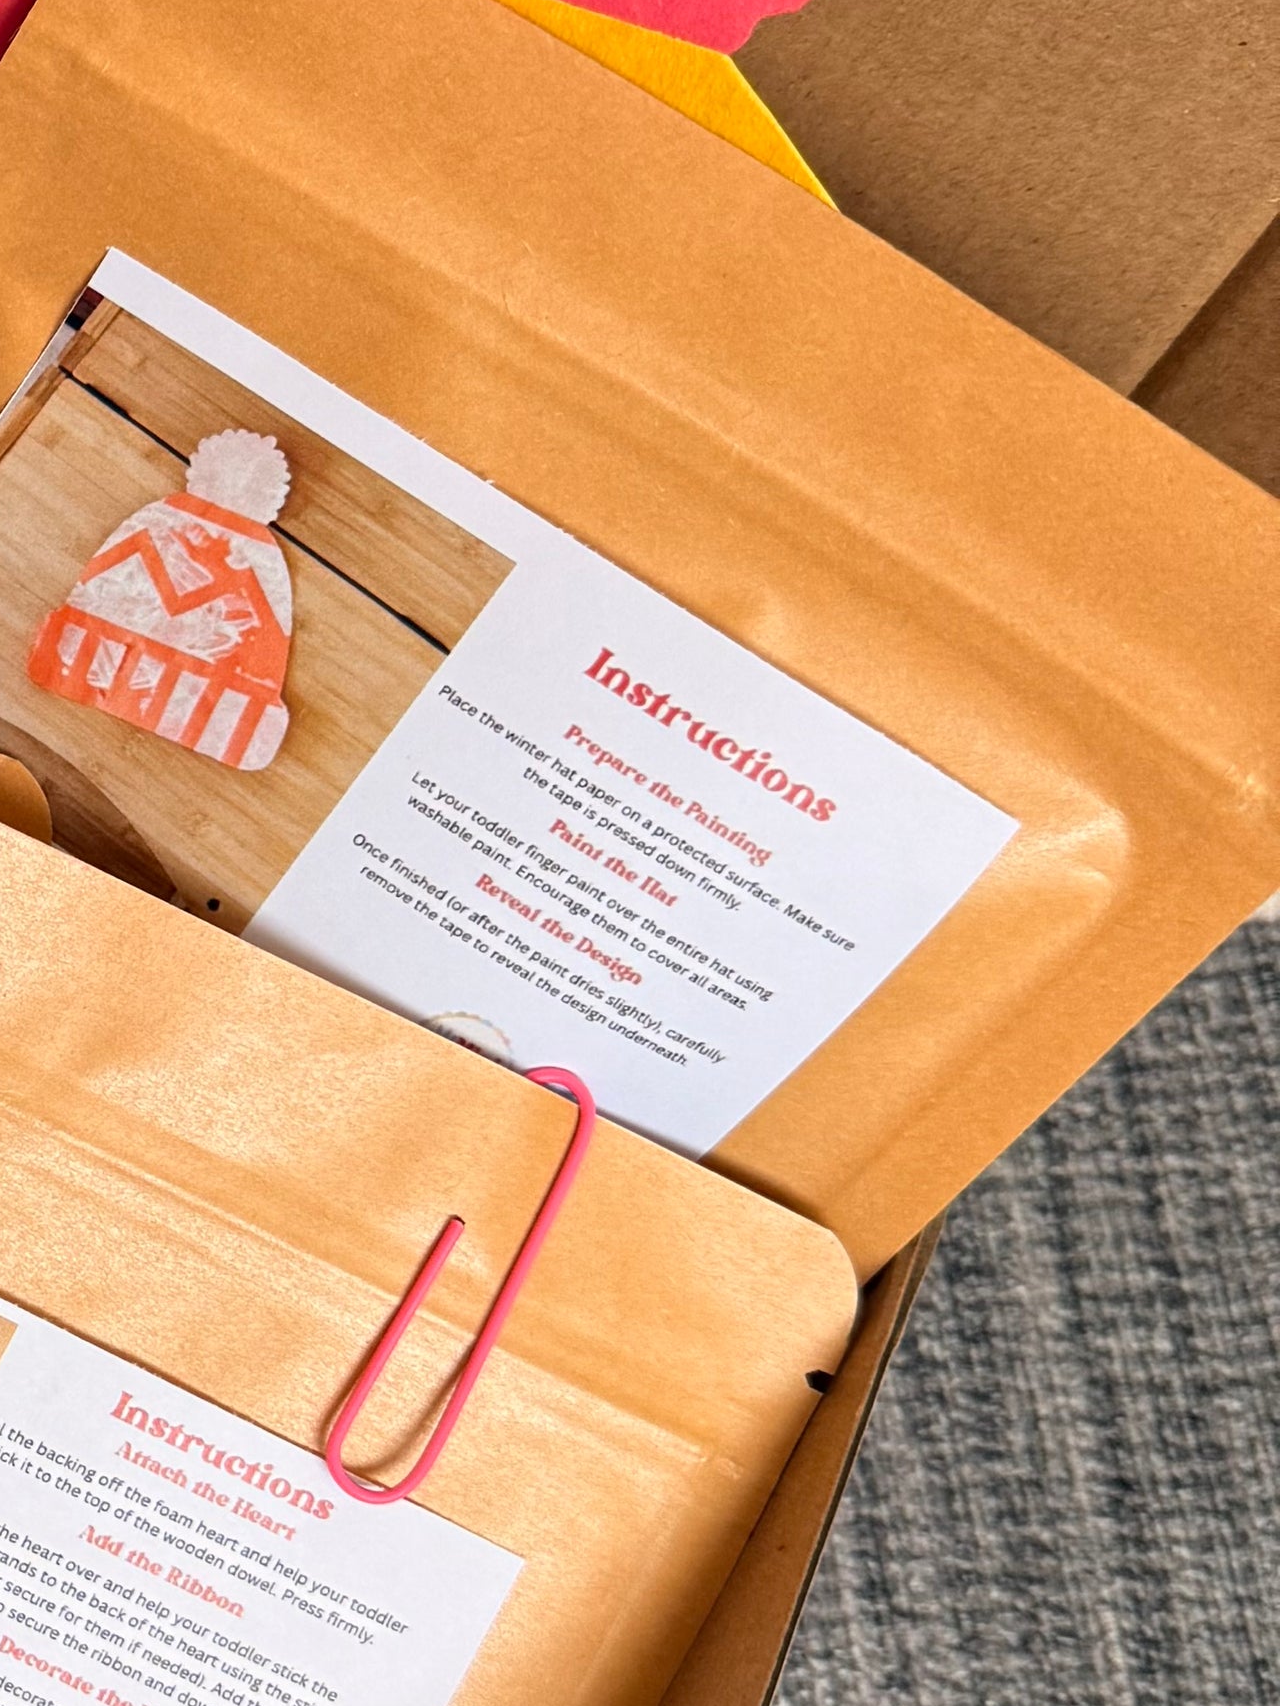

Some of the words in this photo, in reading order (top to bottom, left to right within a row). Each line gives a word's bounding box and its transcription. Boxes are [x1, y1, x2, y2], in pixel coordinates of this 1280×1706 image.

[562, 724, 648, 785] Prepare
[647, 781, 685, 808] the
[683, 800, 773, 867] Painting
[583, 647, 836, 821] Instructions
[411, 771, 437, 794] Let
[433, 788, 472, 814] your
[470, 810, 525, 849] toddler
[524, 844, 569, 877] finger
[564, 873, 607, 903] paint
[606, 898, 641, 922] over
[639, 918, 667, 939] the
[665, 935, 710, 965] entire
[708, 957, 736, 980] hat
[733, 974, 774, 1003] using
[437, 684, 479, 717] Place
[478, 711, 505, 734] the
[504, 729, 552, 763] winter
[550, 757, 578, 782] hat
[574, 777, 622, 808] paper
[620, 805, 642, 823] on
[641, 818, 653, 831] a
[650, 825, 728, 875] protected
[724, 870, 781, 910] surface.
[783, 903, 824, 933] Make
[821, 929, 856, 952] sure
[522, 766, 550, 789] the
[548, 783, 583, 811] tape
[582, 804, 598, 821] is
[594, 816, 658, 857] pressed
[655, 853, 697, 883] down
[696, 876, 742, 911] firmly.
[548, 818, 605, 861] Paint
[602, 857, 639, 882] the
[638, 875, 678, 907] Hat
[474, 873, 543, 923] Reveal
[539, 918, 575, 944] the
[574, 936, 642, 986] Design
[109, 1390, 335, 1520] Instructions
[114, 1441, 188, 1489] Attach
[190, 1481, 231, 1507] the
[230, 1496, 297, 1542] Heart
[6, 1428, 35, 1450] the
[35, 1440, 97, 1484] backing
[97, 1475, 125, 1493] off
[123, 1486, 152, 1508] the
[153, 1499, 194, 1529] foam
[195, 1520, 240, 1553] heart
[239, 1545, 273, 1568] and
[272, 1558, 309, 1587] help
[307, 1580, 349, 1605] your
[349, 1598, 409, 1634] toddler
[19, 1457, 34, 1475] it
[34, 1466, 52, 1484] to
[54, 1476, 82, 1498] the
[83, 1490, 112, 1514] top
[113, 1507, 135, 1523] of
[133, 1515, 161, 1538] the
[162, 1531, 225, 1570] wooden
[227, 1564, 276, 1597] dowel.
[281, 1588, 325, 1619] Press
[326, 1610, 374, 1645] firmly.
[78, 1524, 125, 1557] Add
[124, 1550, 163, 1576] the
[164, 1565, 244, 1618] Ribbon
